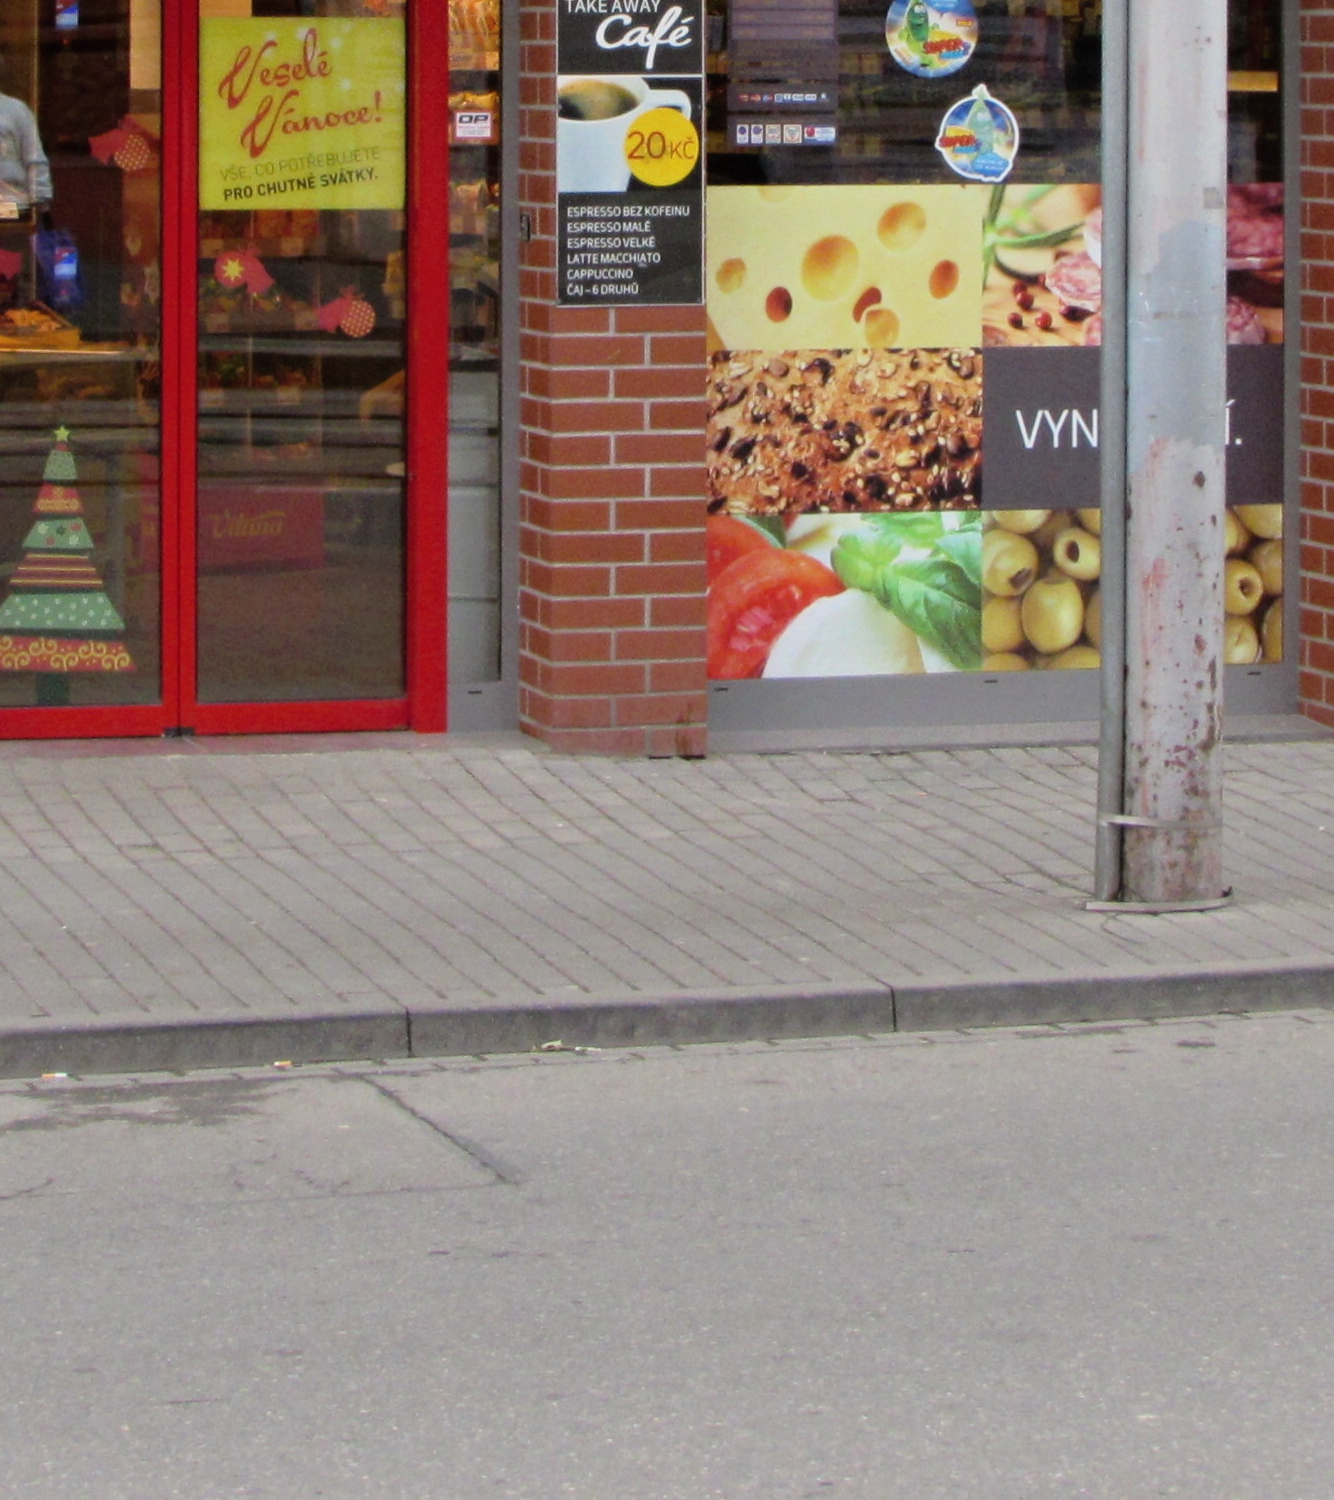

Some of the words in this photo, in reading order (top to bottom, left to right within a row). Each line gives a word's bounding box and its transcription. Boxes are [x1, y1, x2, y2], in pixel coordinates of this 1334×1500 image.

[595, 6, 695, 70] Café
[218, 28, 332, 108] Veselé
[240, 90, 382, 158] Vánoce!
[627, 131, 666, 160] 20
[254, 160, 275, 177] CO
[224, 184, 253, 201] PRO
[257, 174, 315, 196] CHUTNÉ
[319, 167, 378, 188] SVÁTKY.
[567, 206, 621, 218] ESPRESSO
[623, 205, 643, 217] BEZ
[644, 205, 690, 217] KOFEINU
[567, 222, 621, 233] ESPRESSO
[623, 220, 651, 232] MALÉ
[567, 237, 621, 249] ESPRESSO
[622, 235, 655, 248] VELKÉ
[567, 253, 598, 264] LATTE
[600, 252, 661, 264] MACCHIATO
[567, 268, 633, 280] CAPPUCCINO
[567, 283, 584, 297] ČAJ
[592, 285, 599, 295] 6
